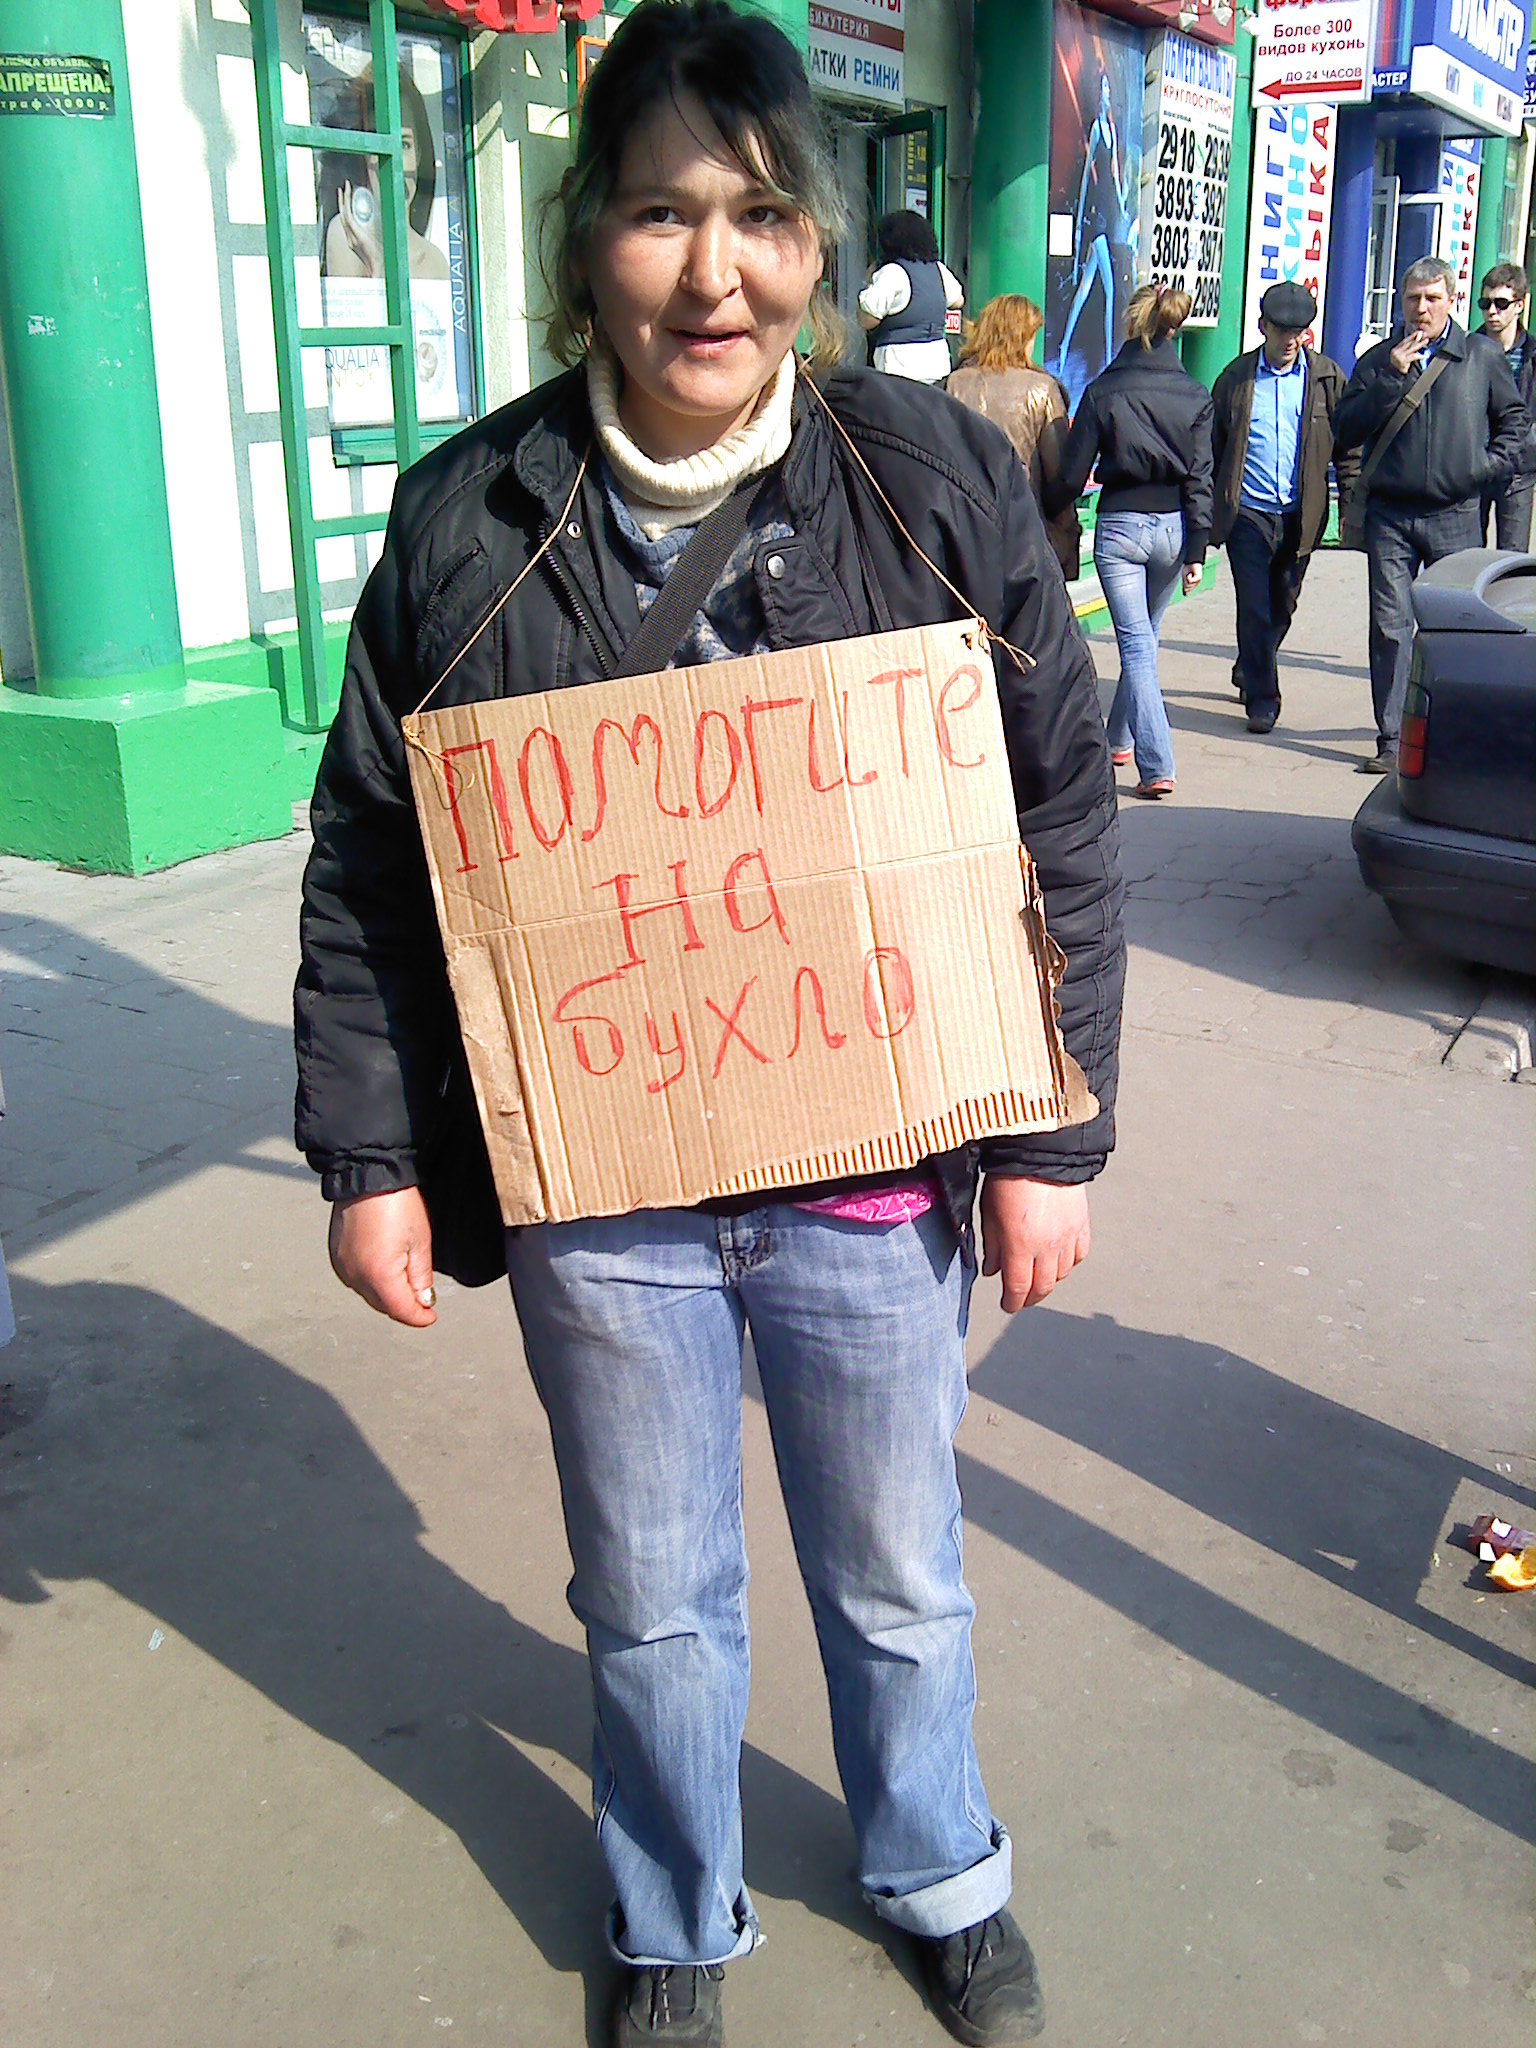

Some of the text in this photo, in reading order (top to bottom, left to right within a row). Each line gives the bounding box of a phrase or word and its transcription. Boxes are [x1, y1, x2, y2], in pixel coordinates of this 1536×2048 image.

[1258, 38, 1365, 57] видов кухонь
[1274, 19, 1352, 38] Более 300
[853, 57, 900, 92] РЕМНИ
[1285, 67, 1362, 82] ДО 24 ЧАСОВ
[1158, 123, 1196, 174] 2918
[1154, 173, 1194, 222] 3893
[1151, 223, 1190, 270] 3803
[448, 222, 467, 334] AQUALIA
